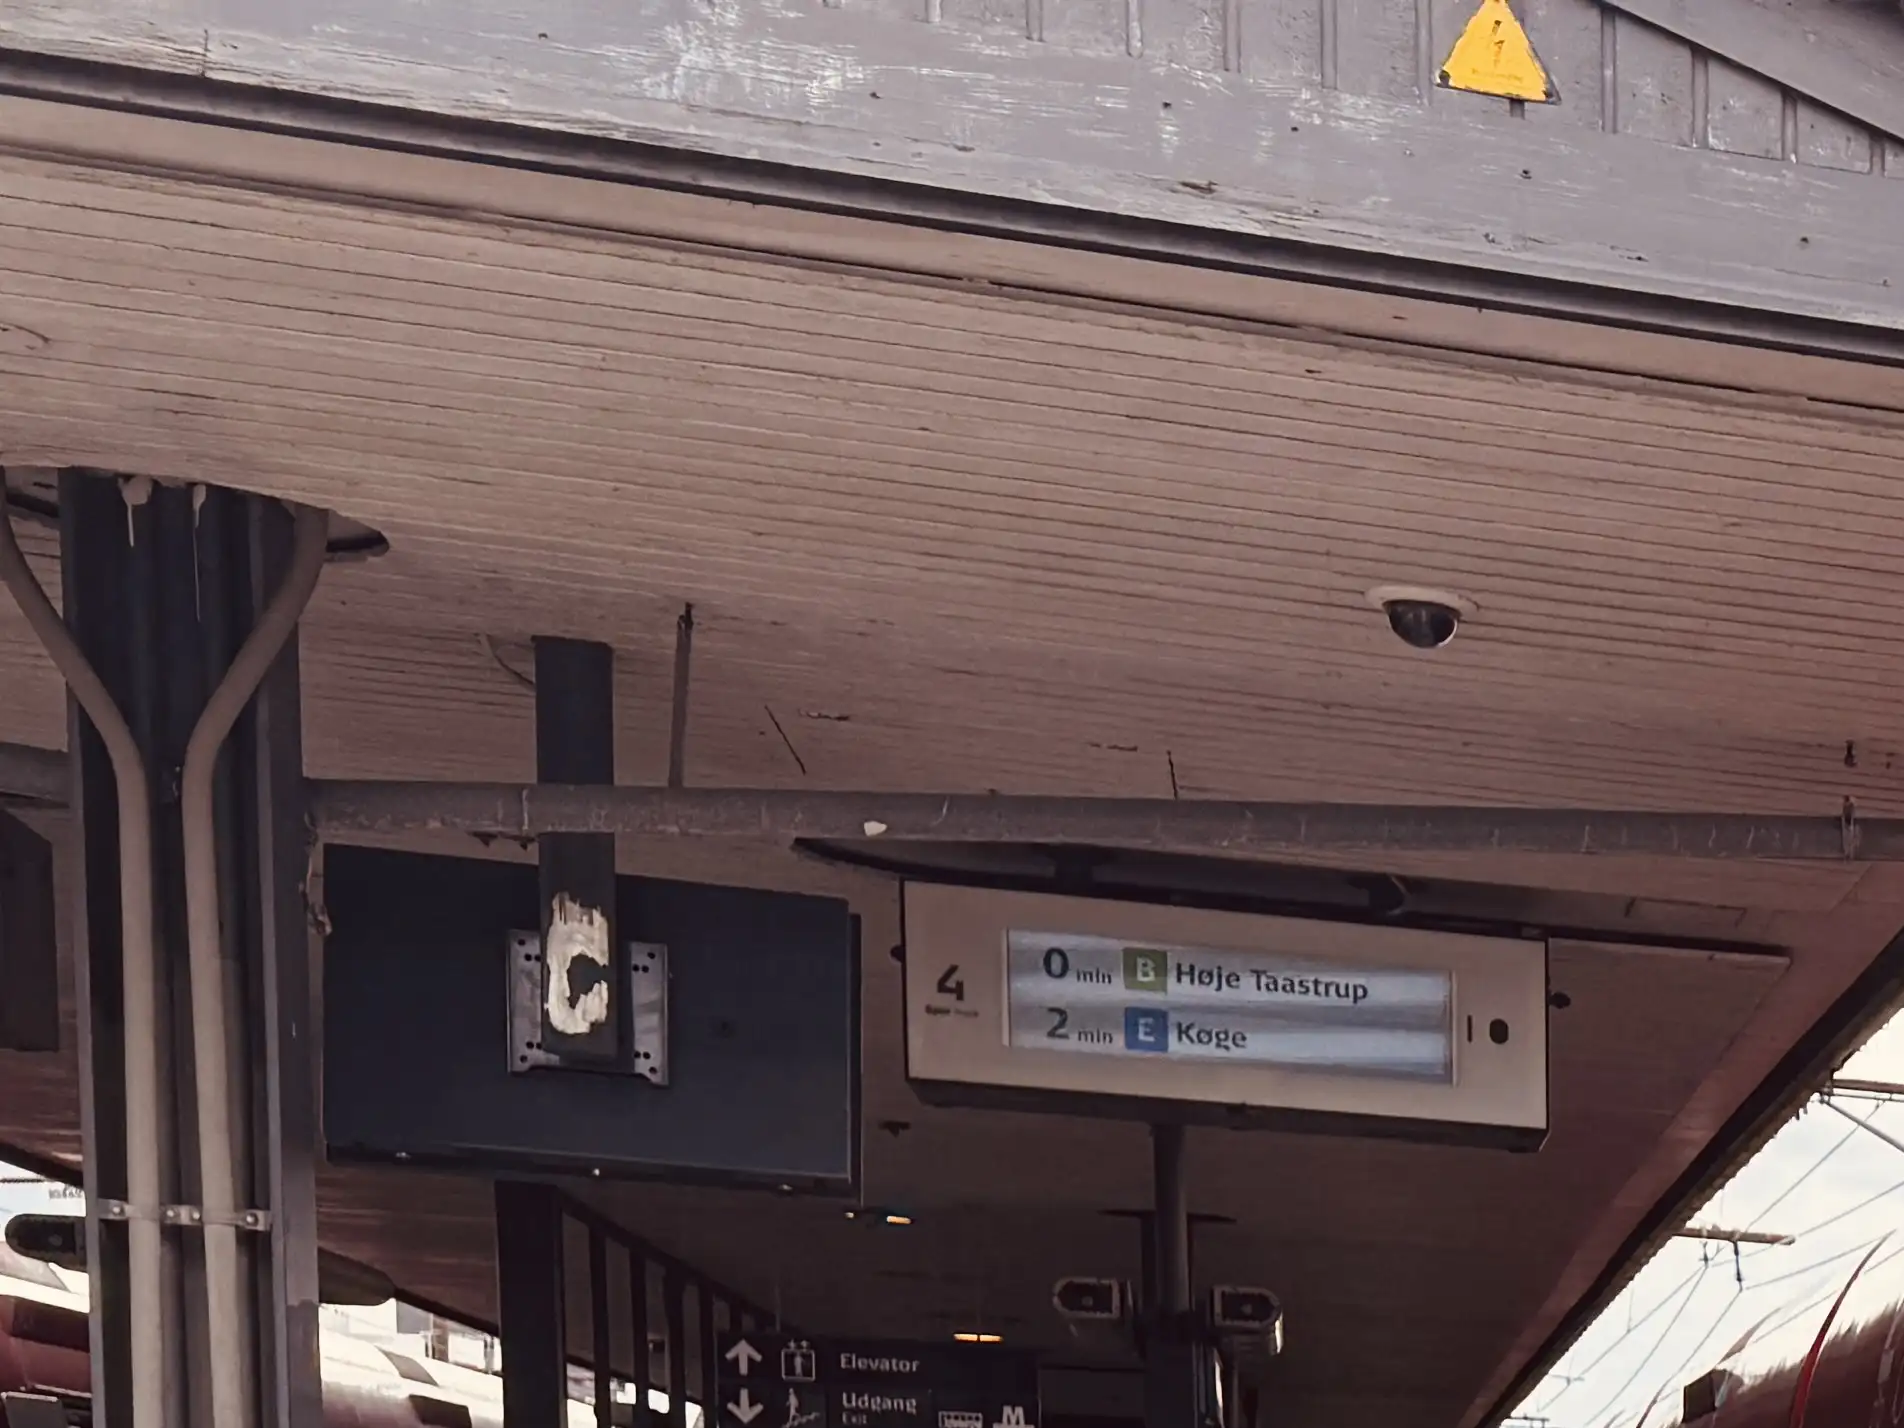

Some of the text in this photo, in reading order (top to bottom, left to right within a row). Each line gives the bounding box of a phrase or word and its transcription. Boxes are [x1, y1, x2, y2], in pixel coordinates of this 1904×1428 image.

[936, 964, 965, 1001] 4
[1042, 947, 1369, 1004] 0 min B Høje Taastrup
[1046, 1006, 1248, 1051] 2 min E Køge
[840, 1352, 920, 1373] Elevator
[842, 1391, 918, 1416] Udgang
[842, 1411, 868, 1425] Exit
